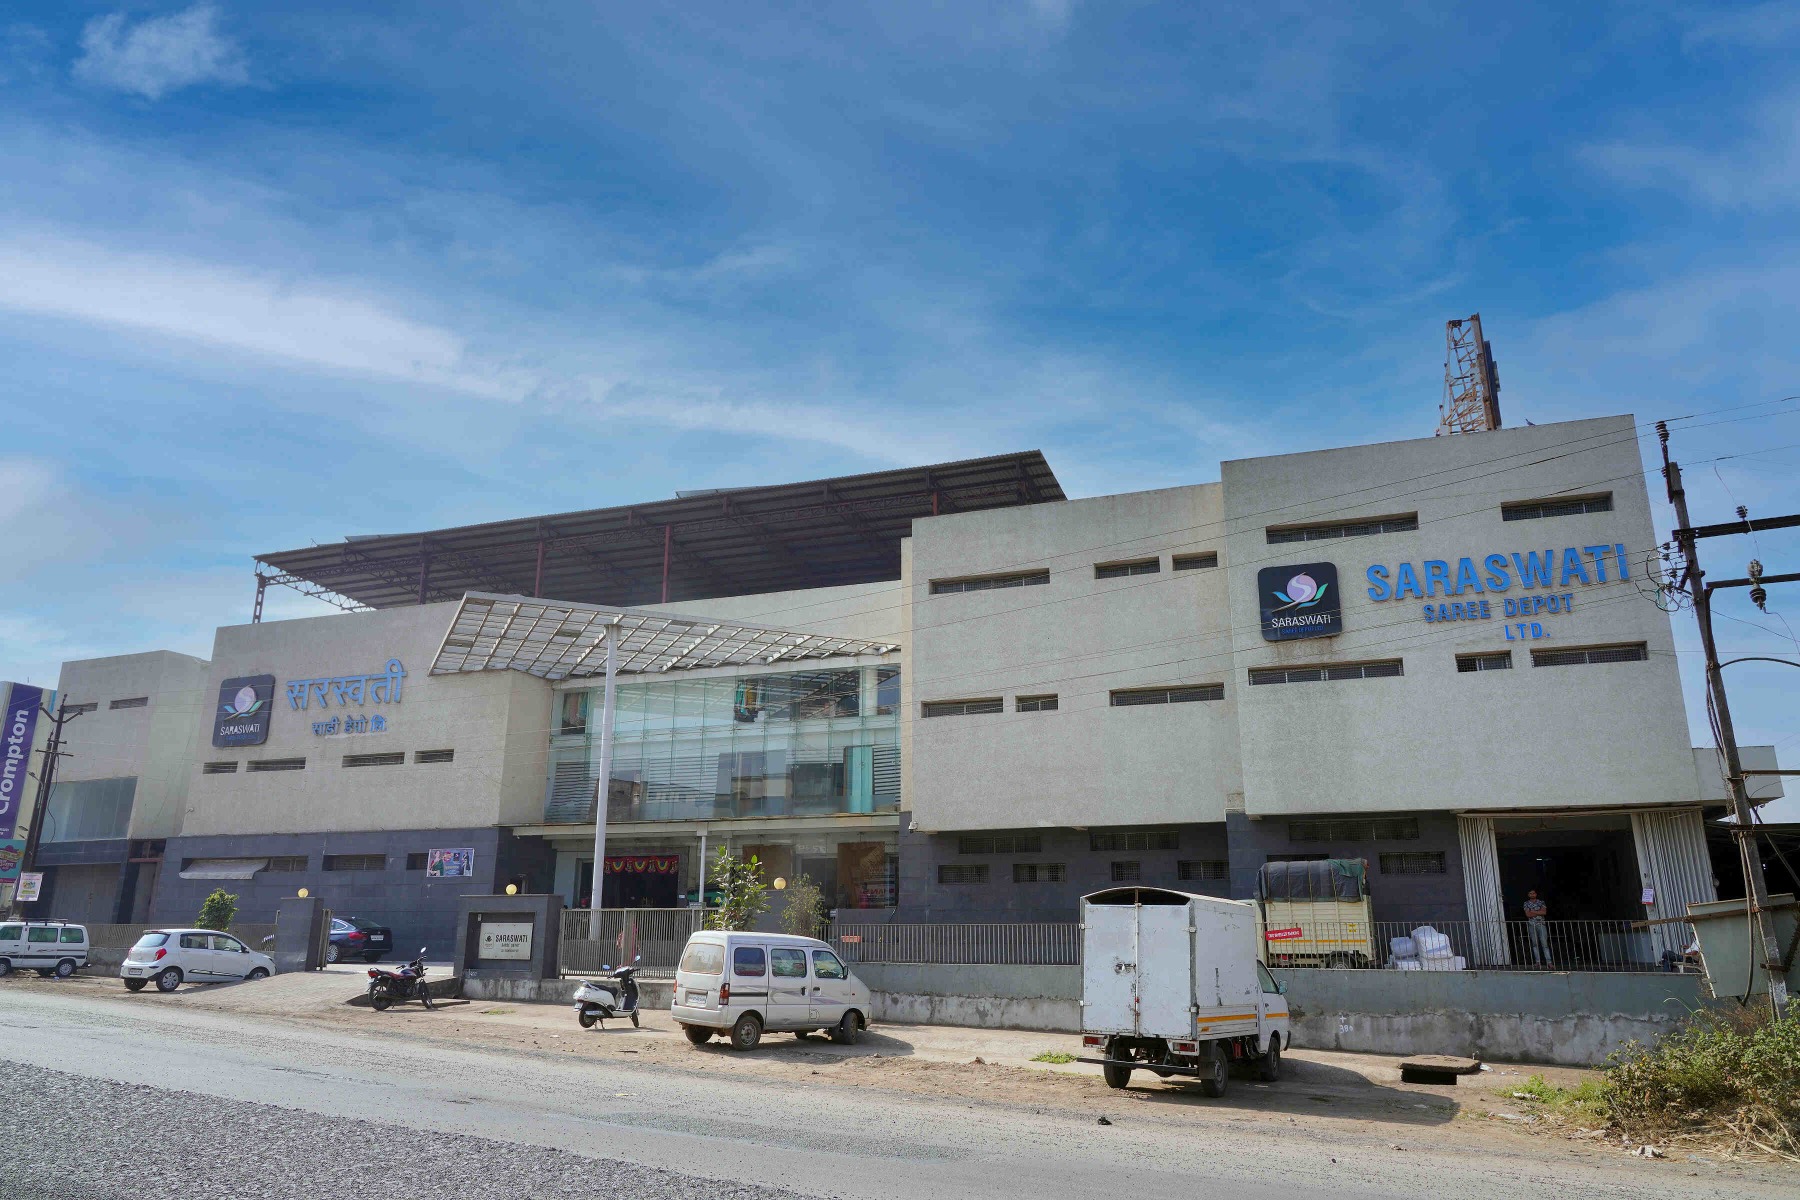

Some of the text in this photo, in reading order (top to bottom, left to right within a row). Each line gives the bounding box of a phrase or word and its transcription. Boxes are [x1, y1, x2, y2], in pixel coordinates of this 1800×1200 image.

[1366, 543, 1630, 602] SARASWATI
[1423, 593, 1574, 623] SAREE DEPOT
[1271, 614, 1331, 628] SARASWATI
[1504, 622, 1551, 641] LTD.
[286, 658, 408, 711] सरस्वती
[220, 724, 260, 735] SARASWATI
[312, 716, 341, 736] साडी
[495, 934, 528, 943] SARASWATI
